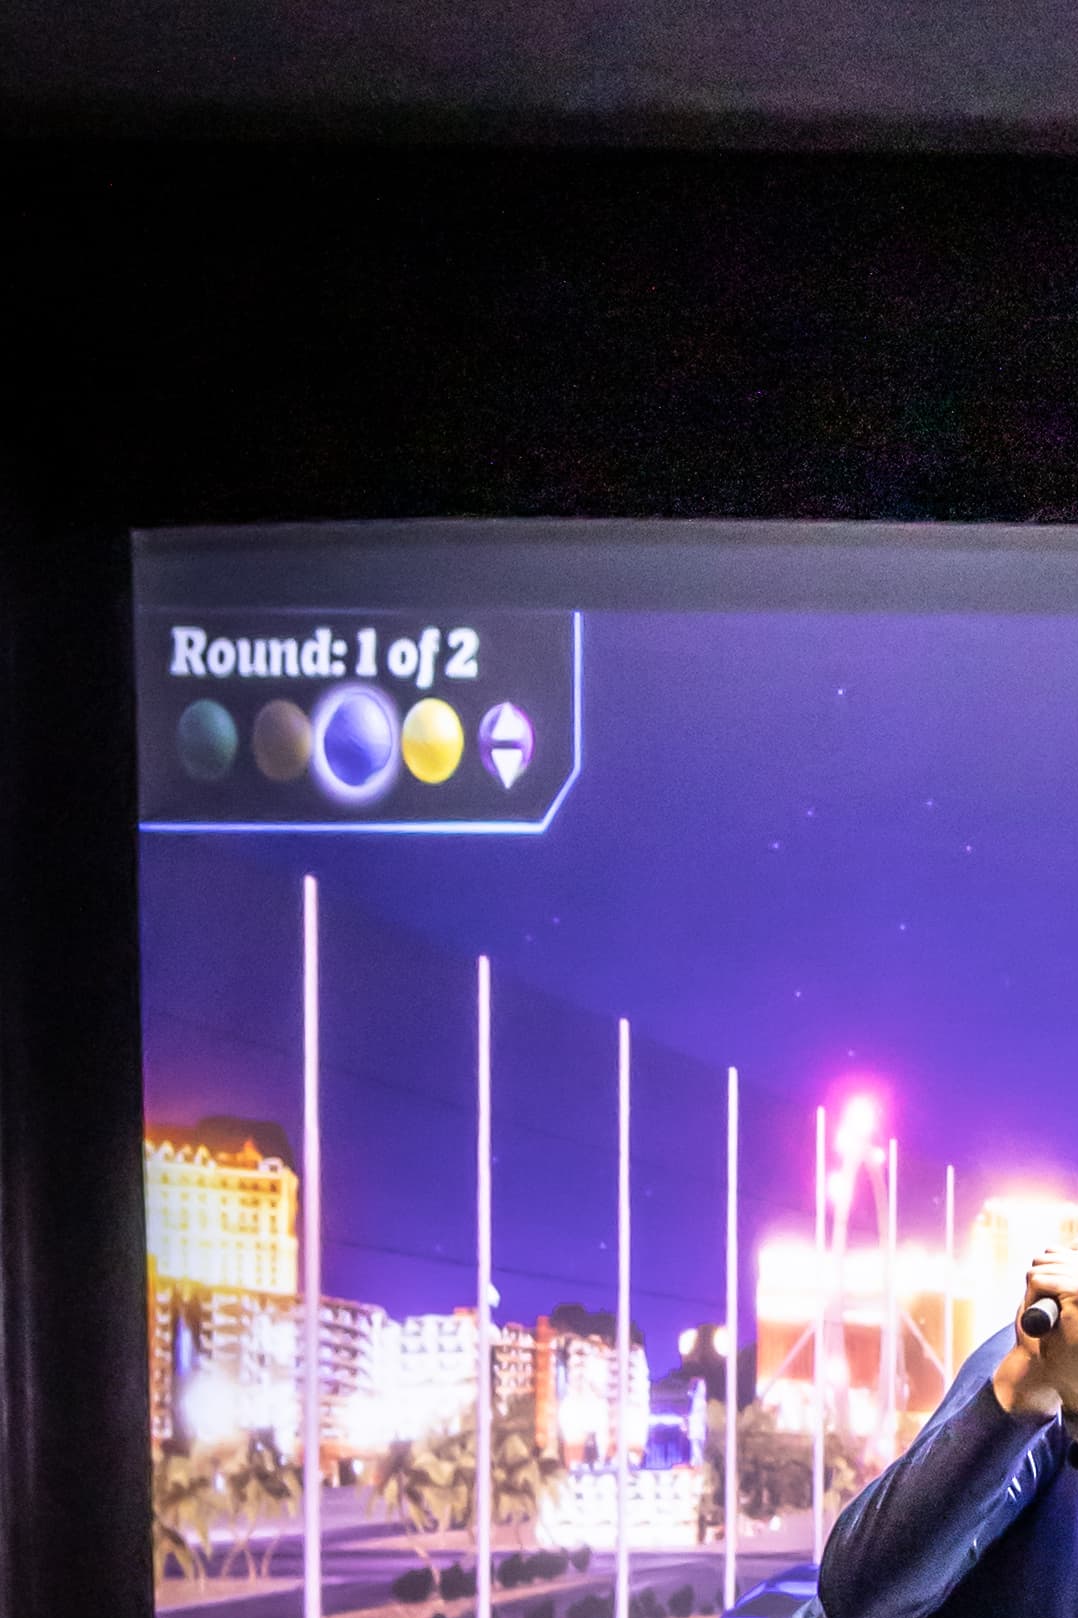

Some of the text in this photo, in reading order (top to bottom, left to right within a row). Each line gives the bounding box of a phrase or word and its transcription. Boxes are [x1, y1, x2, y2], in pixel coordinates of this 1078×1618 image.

[170, 626, 480, 690] Round: 1 of 2
